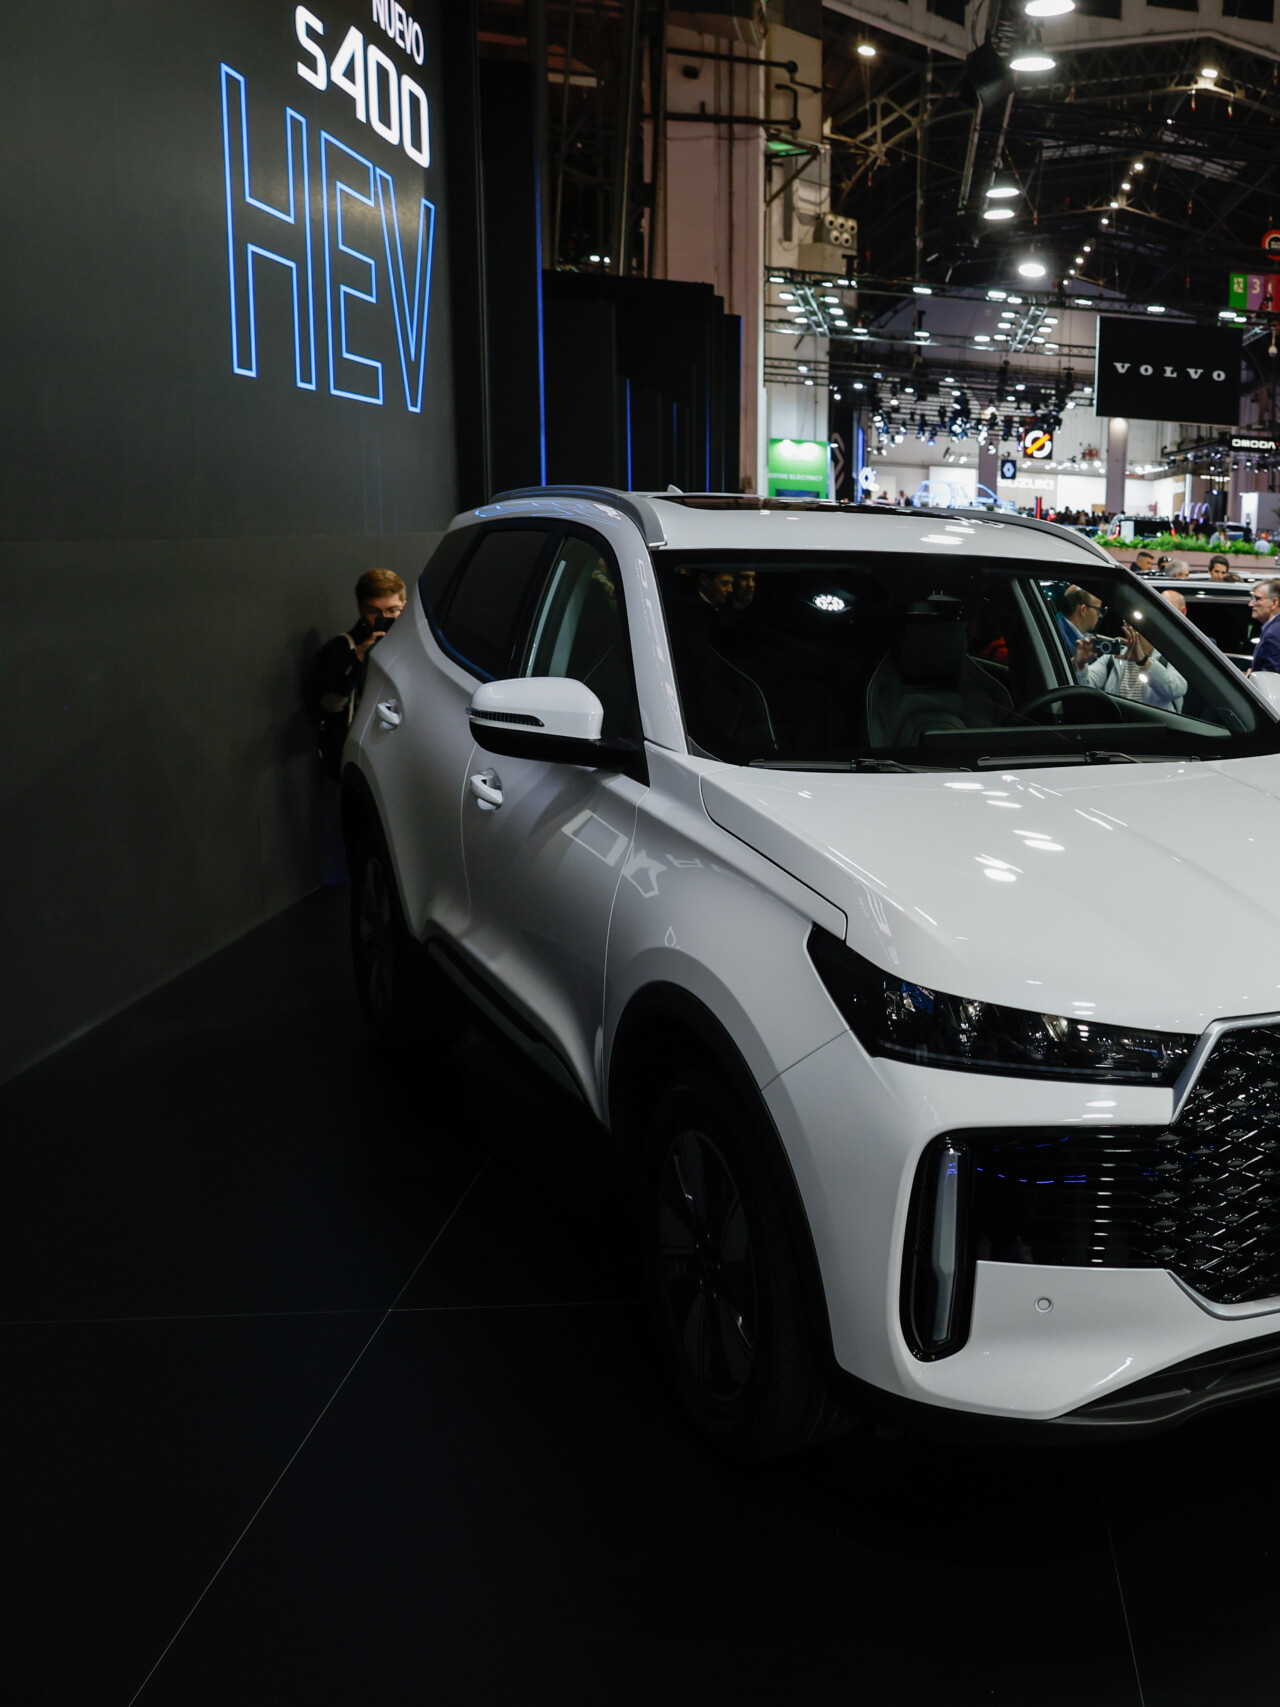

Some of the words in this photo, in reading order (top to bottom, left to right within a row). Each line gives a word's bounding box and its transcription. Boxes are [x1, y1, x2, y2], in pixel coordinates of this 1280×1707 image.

[372, 0, 425, 66] NUEVO
[219, 62, 436, 413] HEV
[1112, 362, 1226, 381] VOLVO
[1231, 438, 1276, 450] OMODA
